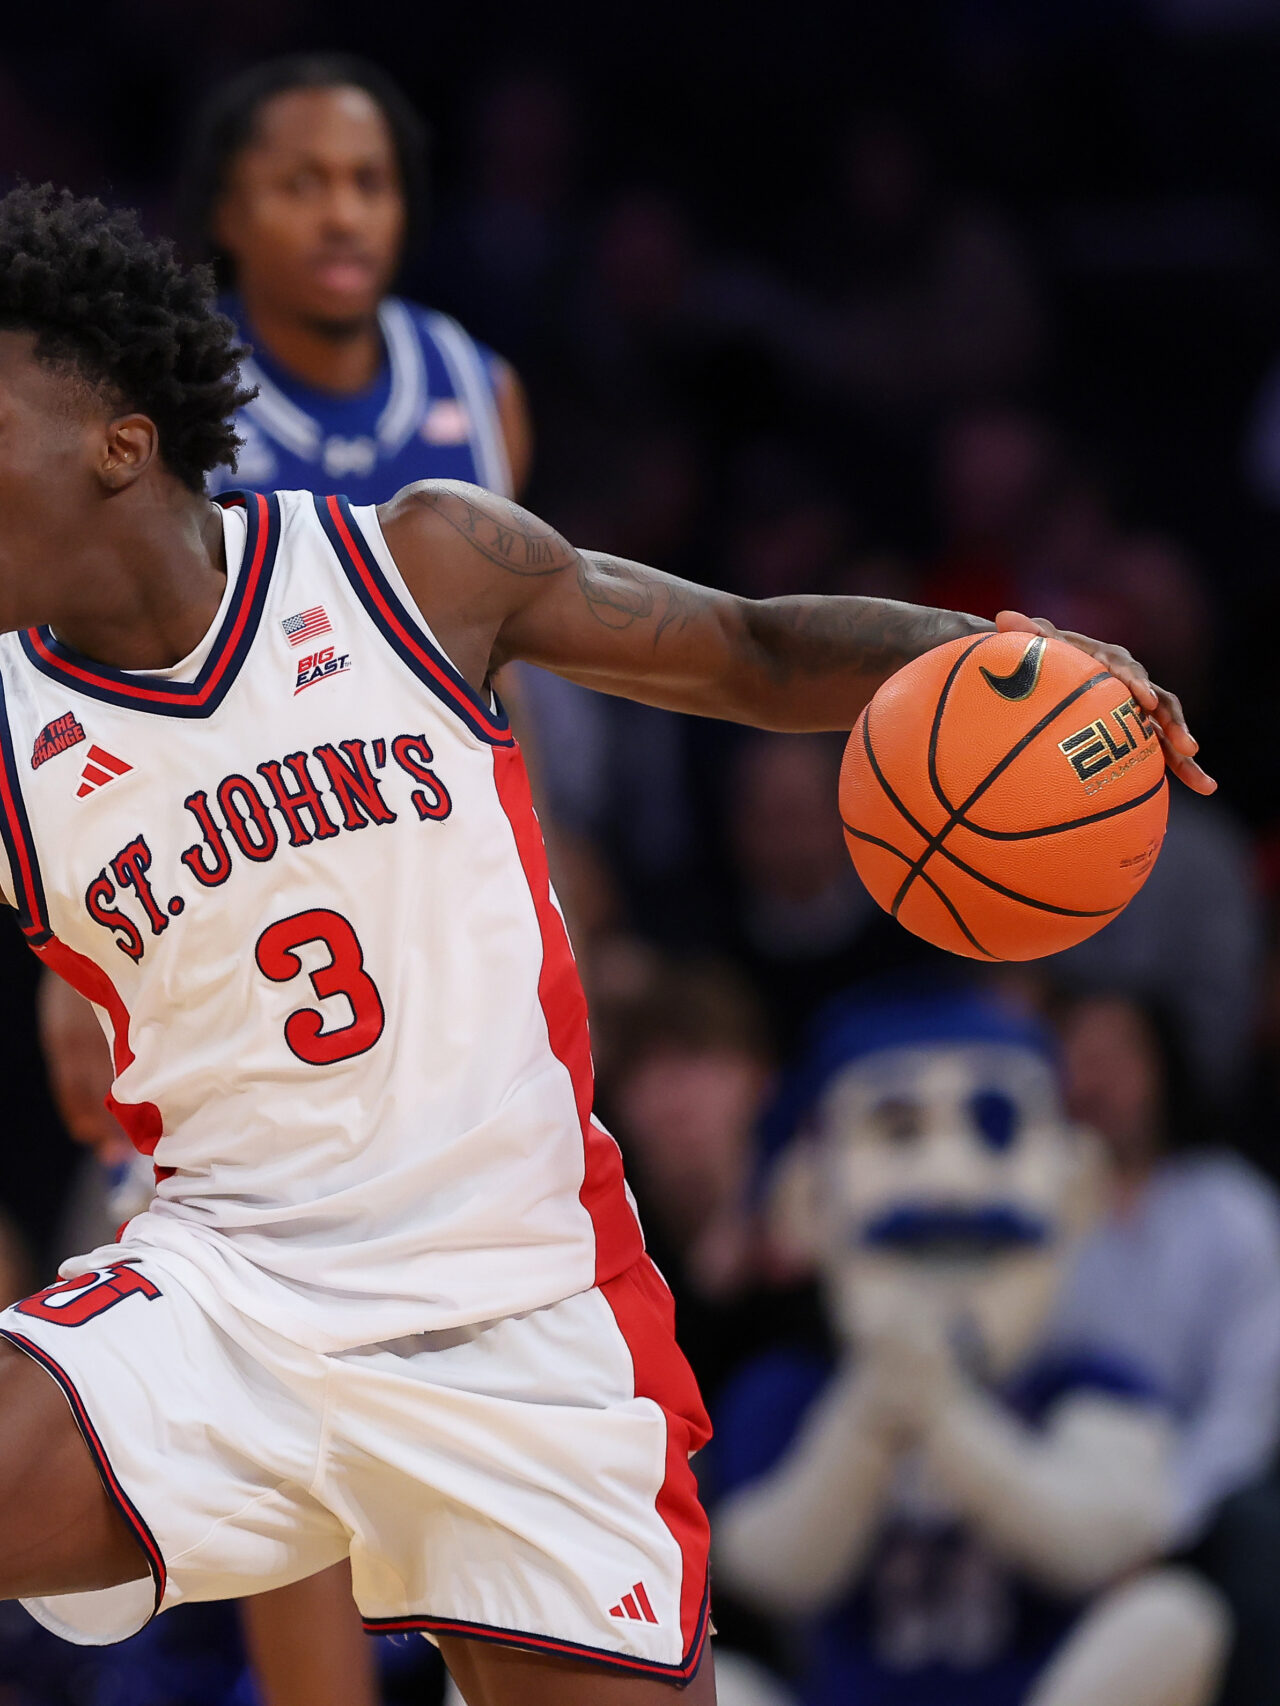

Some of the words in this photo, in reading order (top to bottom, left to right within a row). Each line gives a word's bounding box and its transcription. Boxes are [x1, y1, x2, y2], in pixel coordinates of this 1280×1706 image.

[295, 654, 350, 688] EAST
[297, 645, 335, 674] BIG
[30, 723, 85, 770] CHANGE
[33, 730, 47, 753] BE
[46, 711, 77, 739] THE
[84, 833, 185, 966] ST.
[180, 733, 453, 888] JOHN'S
[254, 907, 386, 1066] 3
